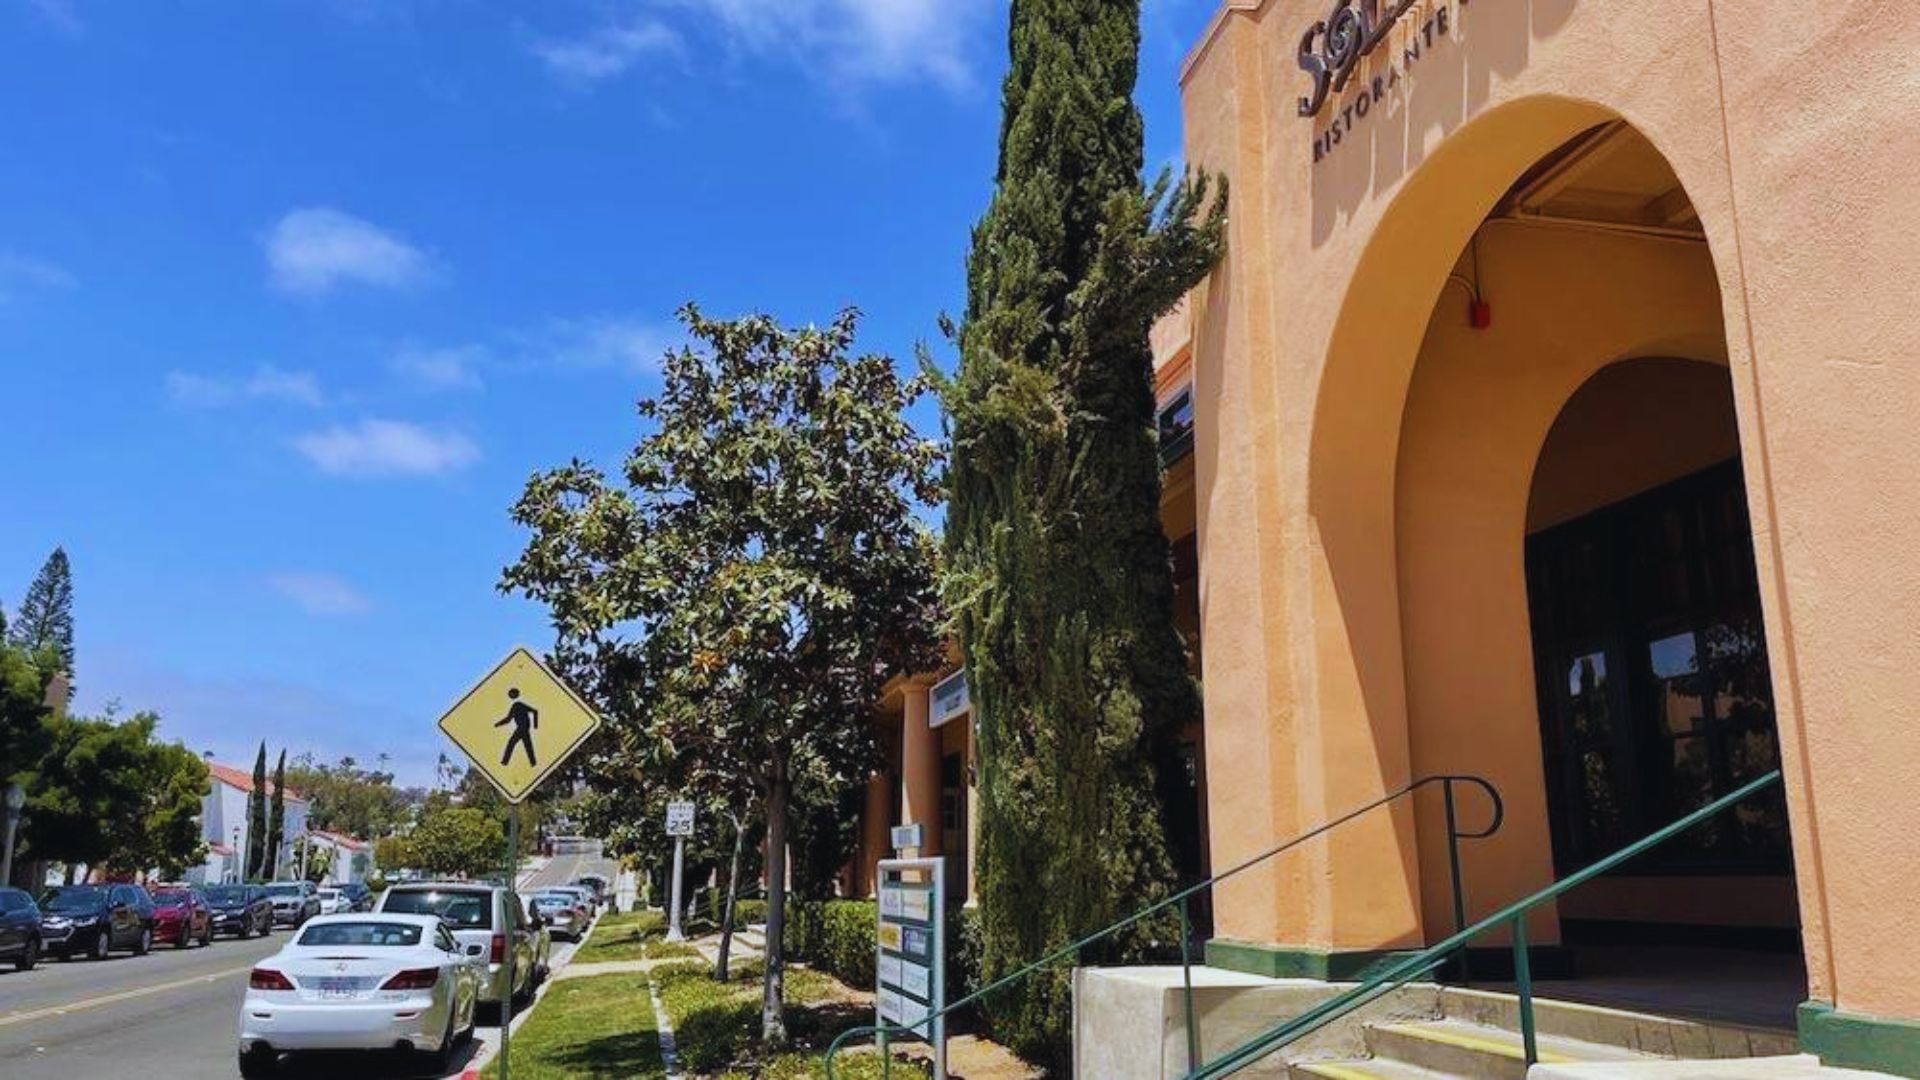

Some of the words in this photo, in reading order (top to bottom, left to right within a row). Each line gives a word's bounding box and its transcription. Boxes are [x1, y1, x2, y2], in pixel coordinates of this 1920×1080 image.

[1298, 0, 1420, 117] SOL
[1313, 6, 1449, 163] RISTORANTE
[670, 820, 690, 833] 25
